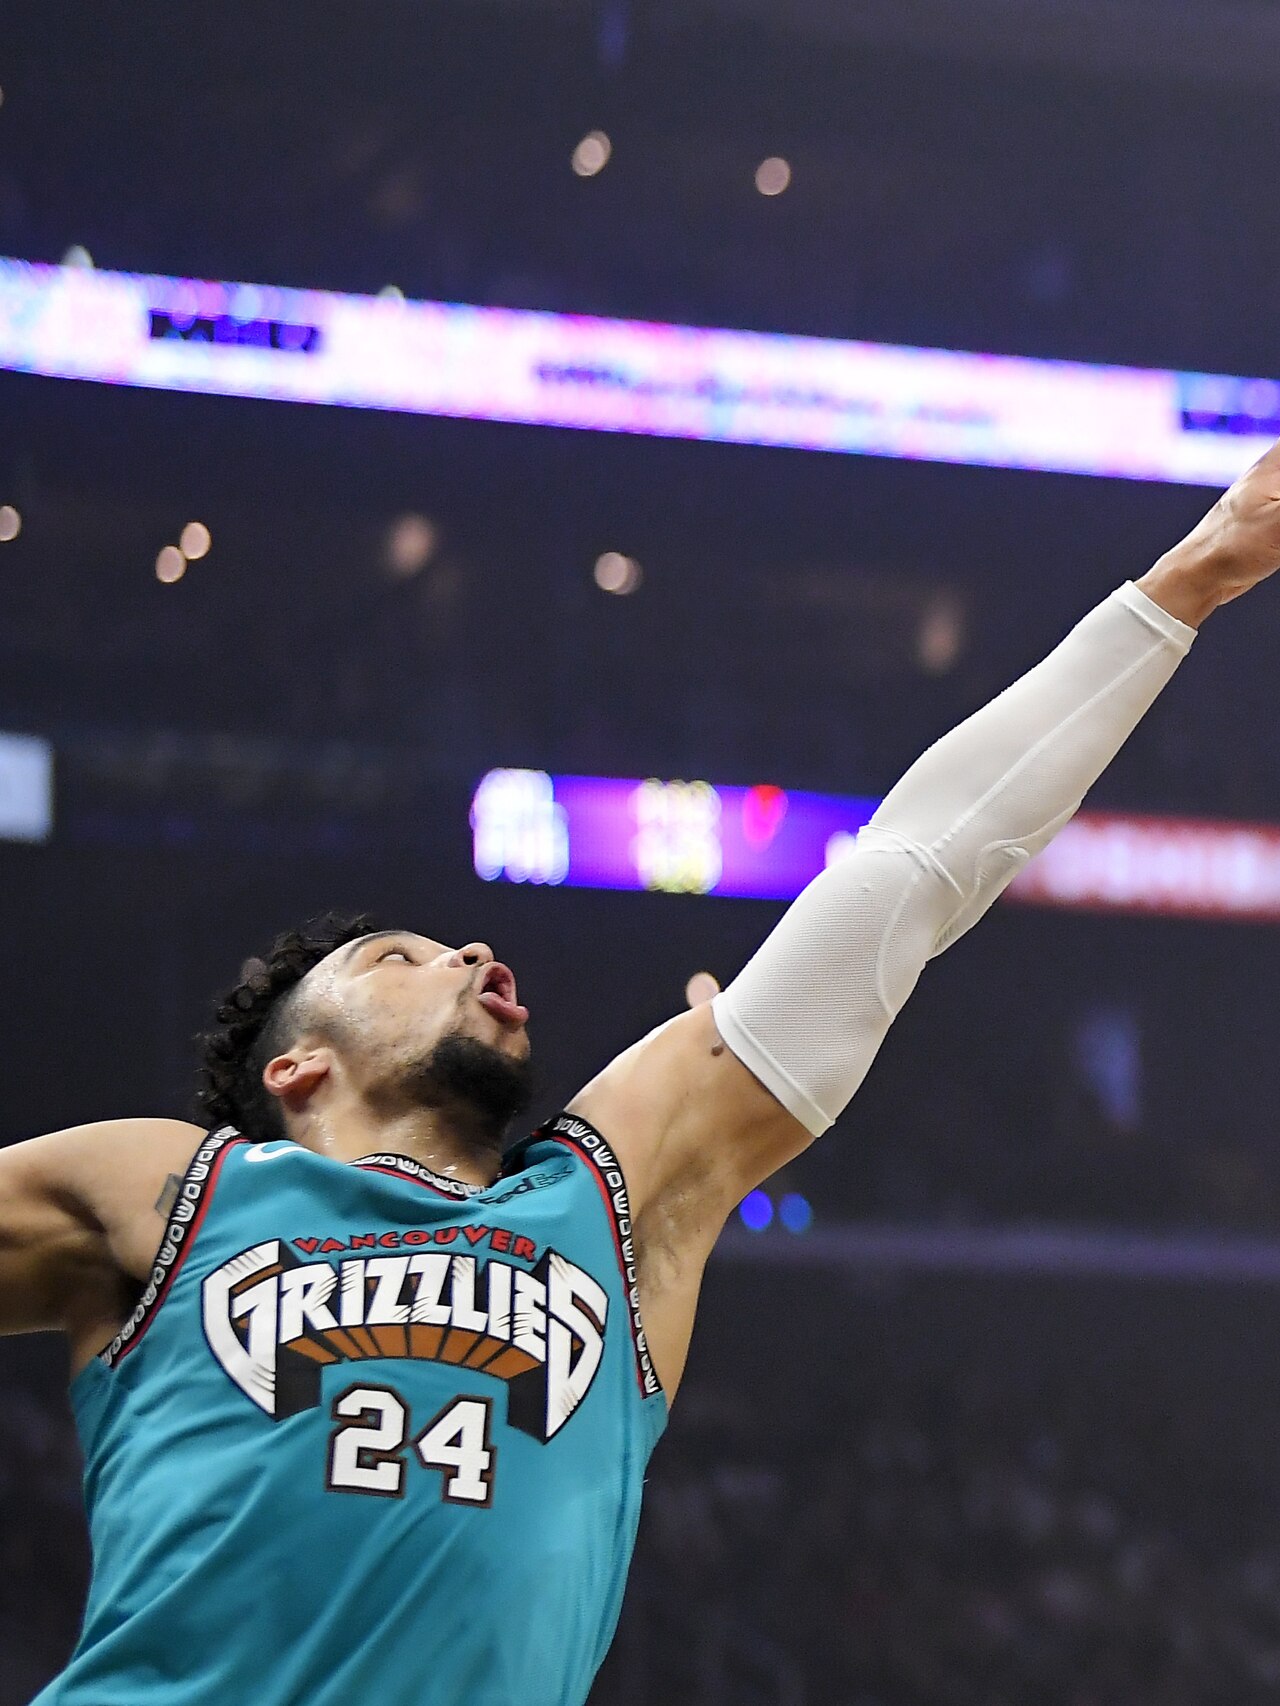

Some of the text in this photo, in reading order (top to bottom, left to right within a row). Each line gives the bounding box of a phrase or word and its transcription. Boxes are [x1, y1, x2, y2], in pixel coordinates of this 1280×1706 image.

[293, 1224, 538, 1263] VANCOUVER
[201, 1239, 610, 1444] GRIZZLIES
[326, 1382, 497, 1509] 24
